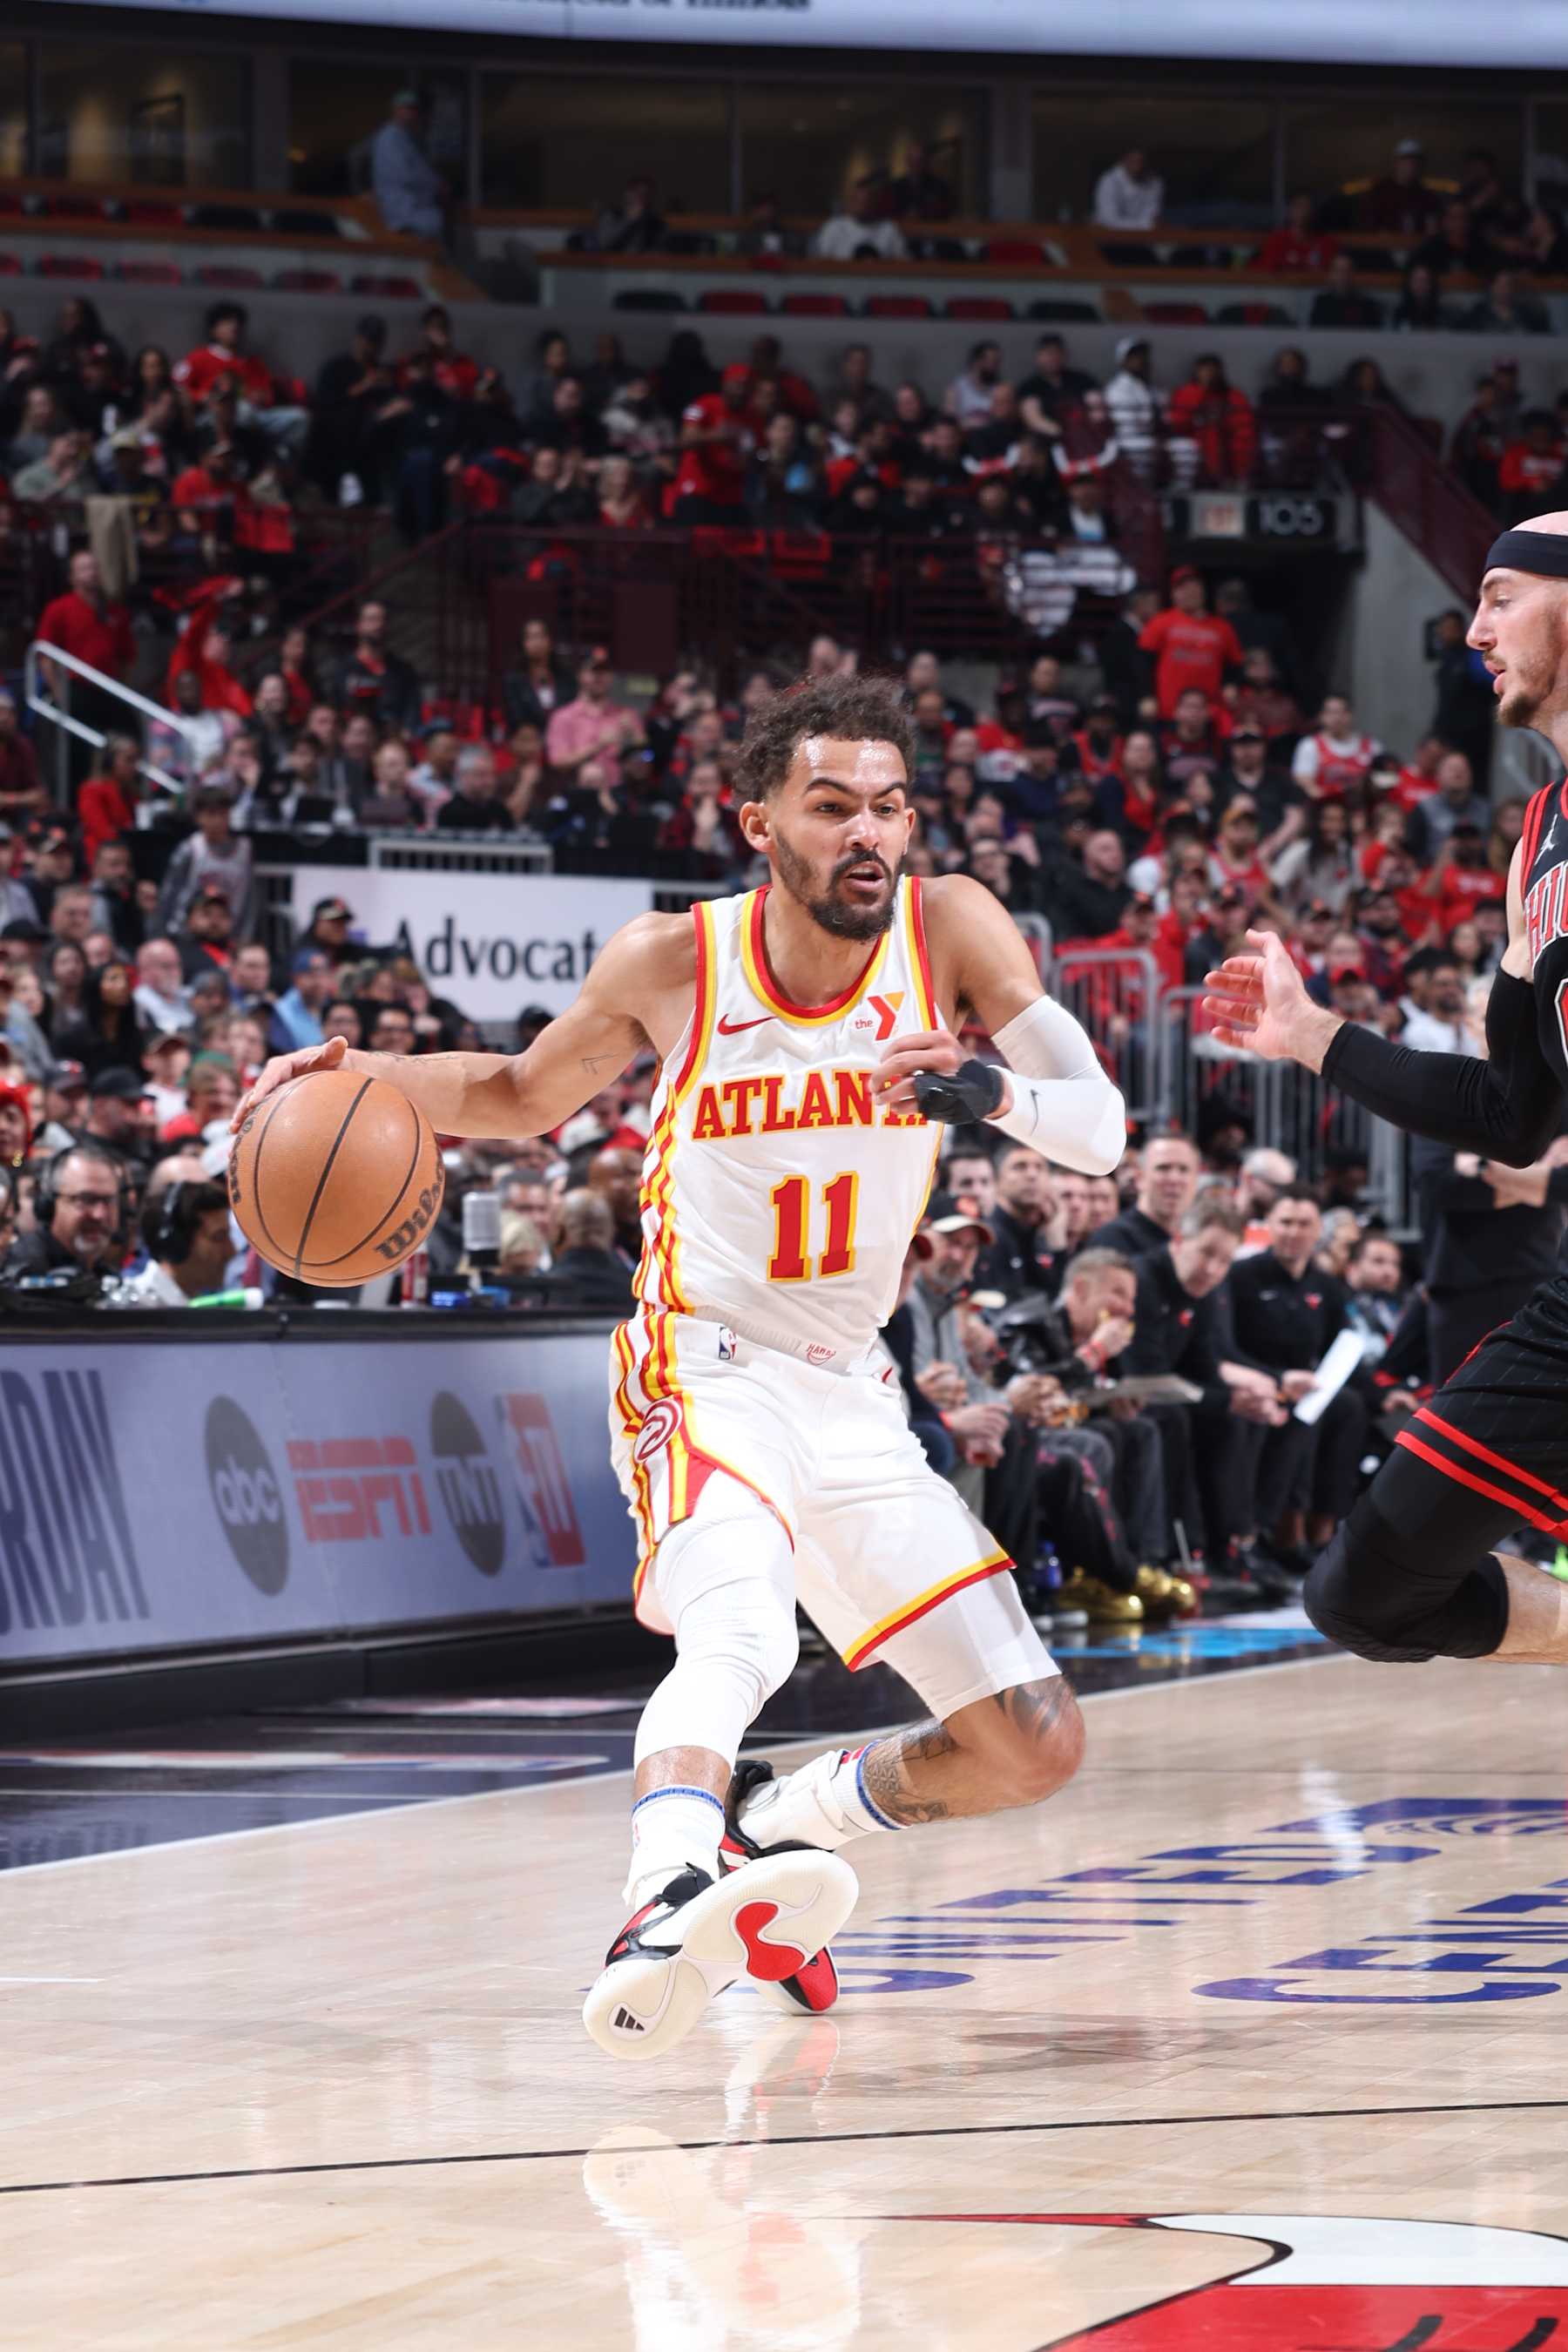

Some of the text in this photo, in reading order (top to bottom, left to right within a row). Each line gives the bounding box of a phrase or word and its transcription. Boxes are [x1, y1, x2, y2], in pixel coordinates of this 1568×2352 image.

[396, 915, 598, 981] Advocat
[855, 1017, 874, 1030] the
[692, 1069, 930, 1140] ATLAN
[767, 1170, 860, 1283] 11
[0, 1369, 151, 1637] RDAY
[214, 1453, 281, 1526] abc
[285, 1436, 433, 1542] ESPN
